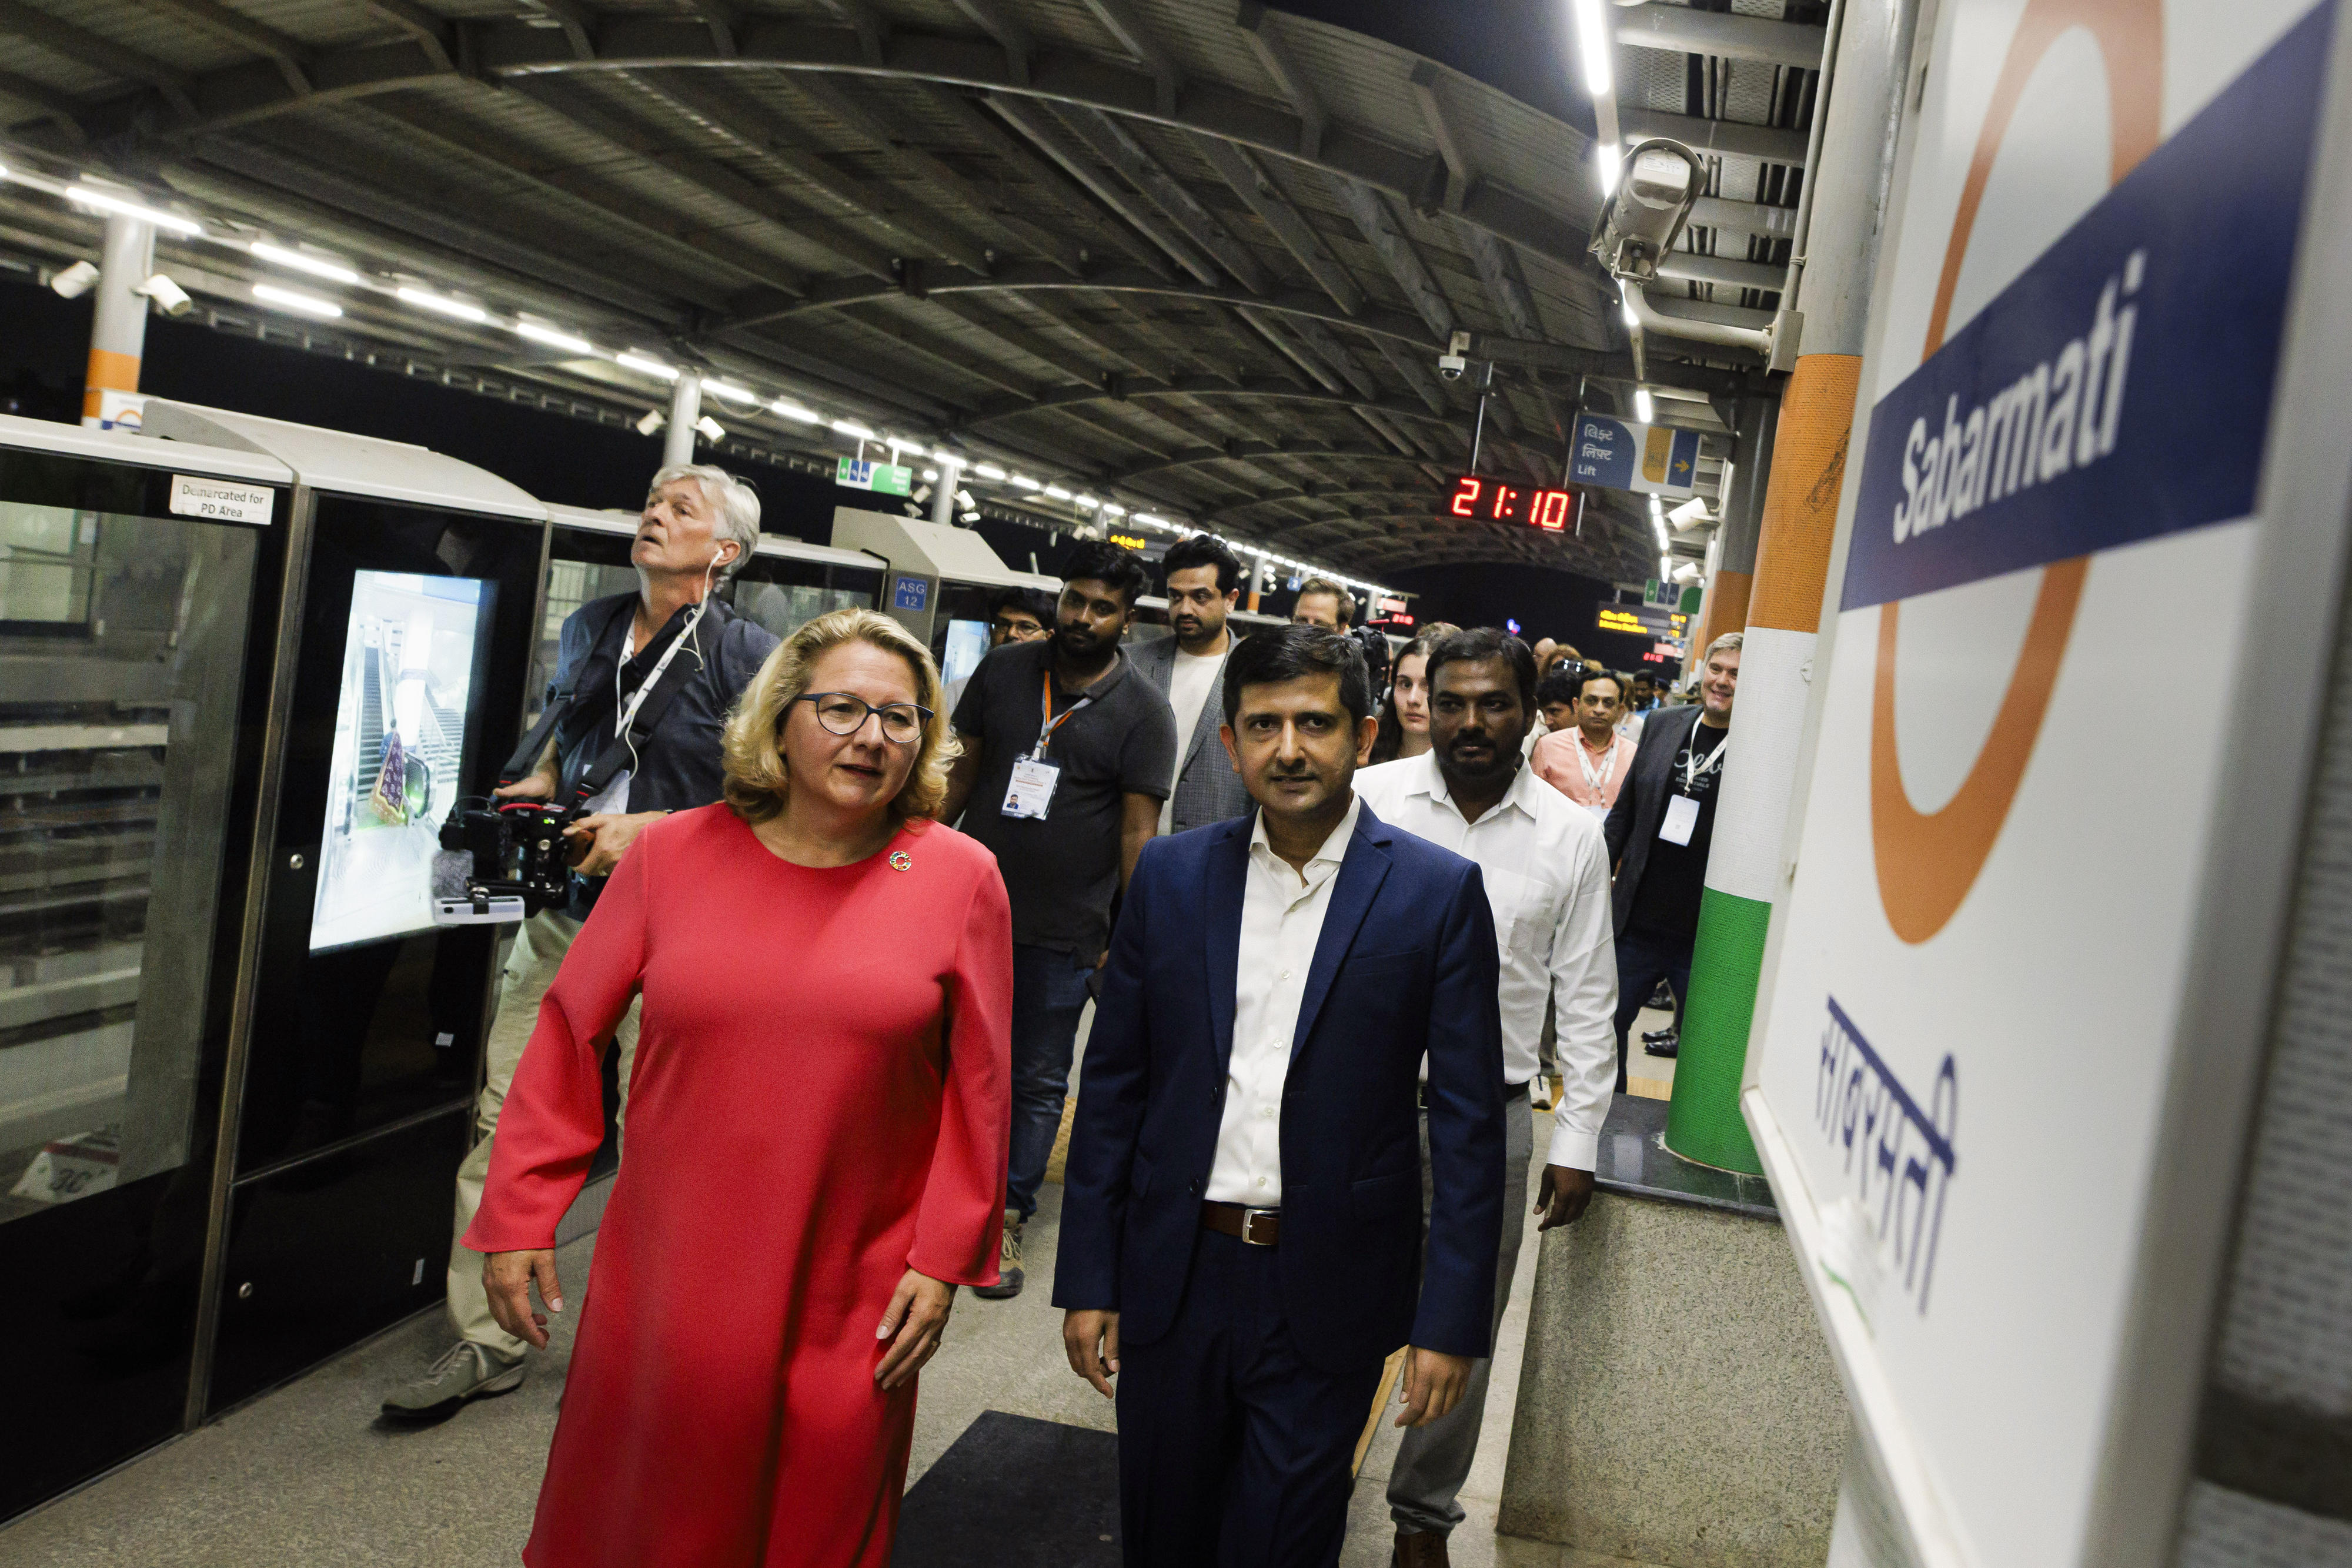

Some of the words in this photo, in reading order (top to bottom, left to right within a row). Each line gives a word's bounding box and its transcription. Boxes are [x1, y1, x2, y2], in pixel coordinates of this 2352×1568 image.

[1893, 249, 2147, 544] Sabarmati
[1578, 464, 1597, 476] Lift
[249, 493, 264, 504] for
[1452, 477, 1569, 529] 21:10
[201, 503, 216, 514] PD
[219, 506, 242, 517] Area
[898, 581, 925, 594] ASG
[904, 595, 918, 606] 12
